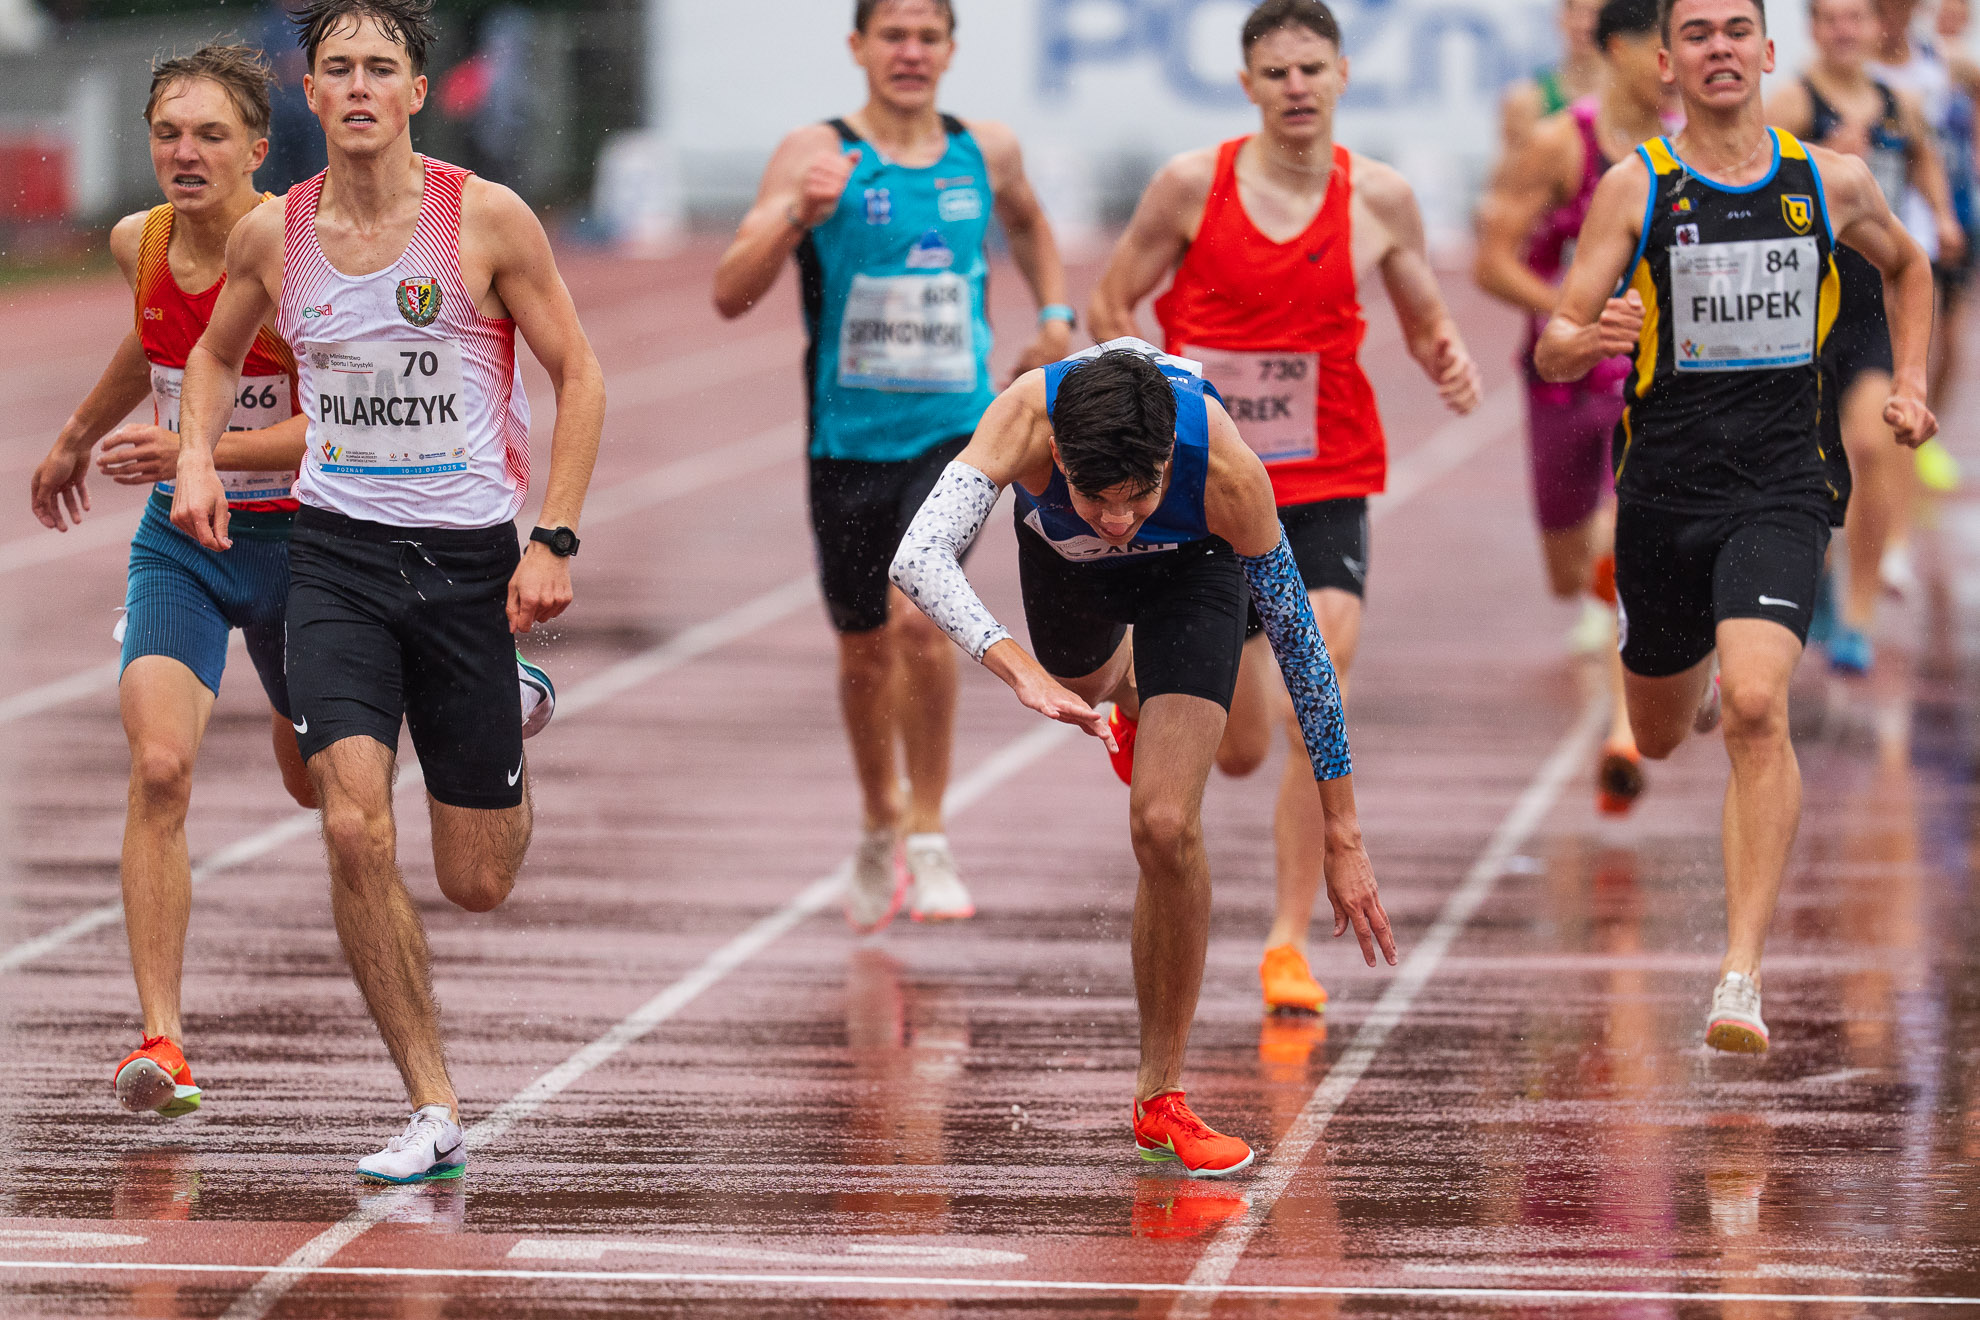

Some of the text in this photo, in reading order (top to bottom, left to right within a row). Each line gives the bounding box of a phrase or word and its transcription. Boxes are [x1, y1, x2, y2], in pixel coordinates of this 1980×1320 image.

[1766, 248, 1799, 272] 84
[1691, 289, 1802, 323] FILIPEK
[400, 351, 438, 377] 70
[1259, 359, 1308, 381] 730
[320, 393, 459, 426] PILARCZYK
